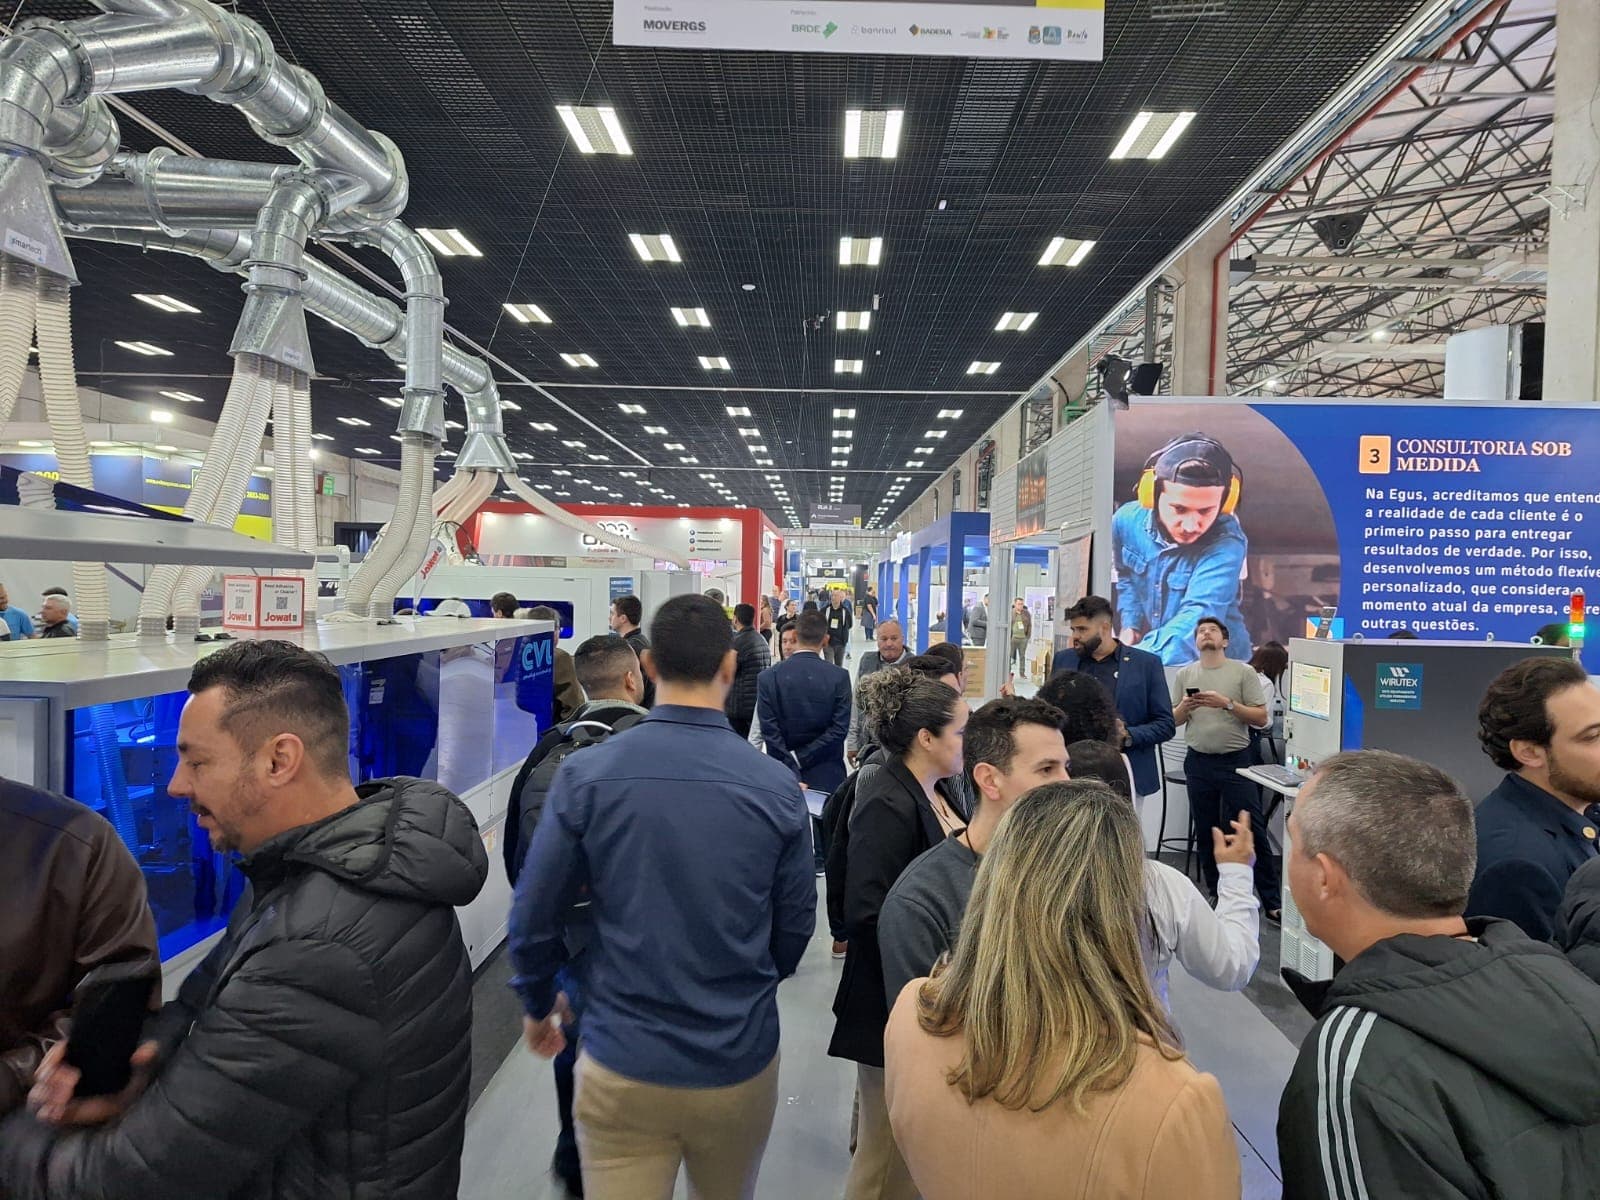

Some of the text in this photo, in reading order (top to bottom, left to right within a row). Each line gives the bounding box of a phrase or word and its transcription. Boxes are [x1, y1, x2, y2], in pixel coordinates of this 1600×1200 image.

[643, 19, 707, 31] MOVERGS
[791, 24, 821, 33] BRDE
[1397, 438, 1572, 456] CONSULTORIA SOB
[1369, 448, 1380, 464] 3
[1396, 456, 1481, 472] MEDIDA
[1366, 488, 1384, 500] Na
[1389, 488, 1427, 503] Egus,
[1432, 489, 1519, 502] acreditamos
[1524, 492, 1550, 505] que
[1365, 507, 1583, 522] a realidade de cada cliente é o
[1364, 525, 1573, 543] primeiro passo para entregar
[1364, 544, 1592, 561] resultados de verdade. Por isso,
[1363, 562, 1470, 575] desenvolvemos
[1475, 565, 1496, 576] um
[1501, 563, 1553, 577] método
[1363, 581, 1466, 595] personalizado,
[1471, 584, 1497, 596] que
[1501, 584, 1570, 596] considera
[1362, 600, 1600, 616] momento atual da empresa, ere
[228, 610, 248, 622] Jowat
[264, 611, 292, 622] Jowat
[1361, 618, 1479, 633] outras questões.
[1380, 677, 1418, 688] WIRUTEX
